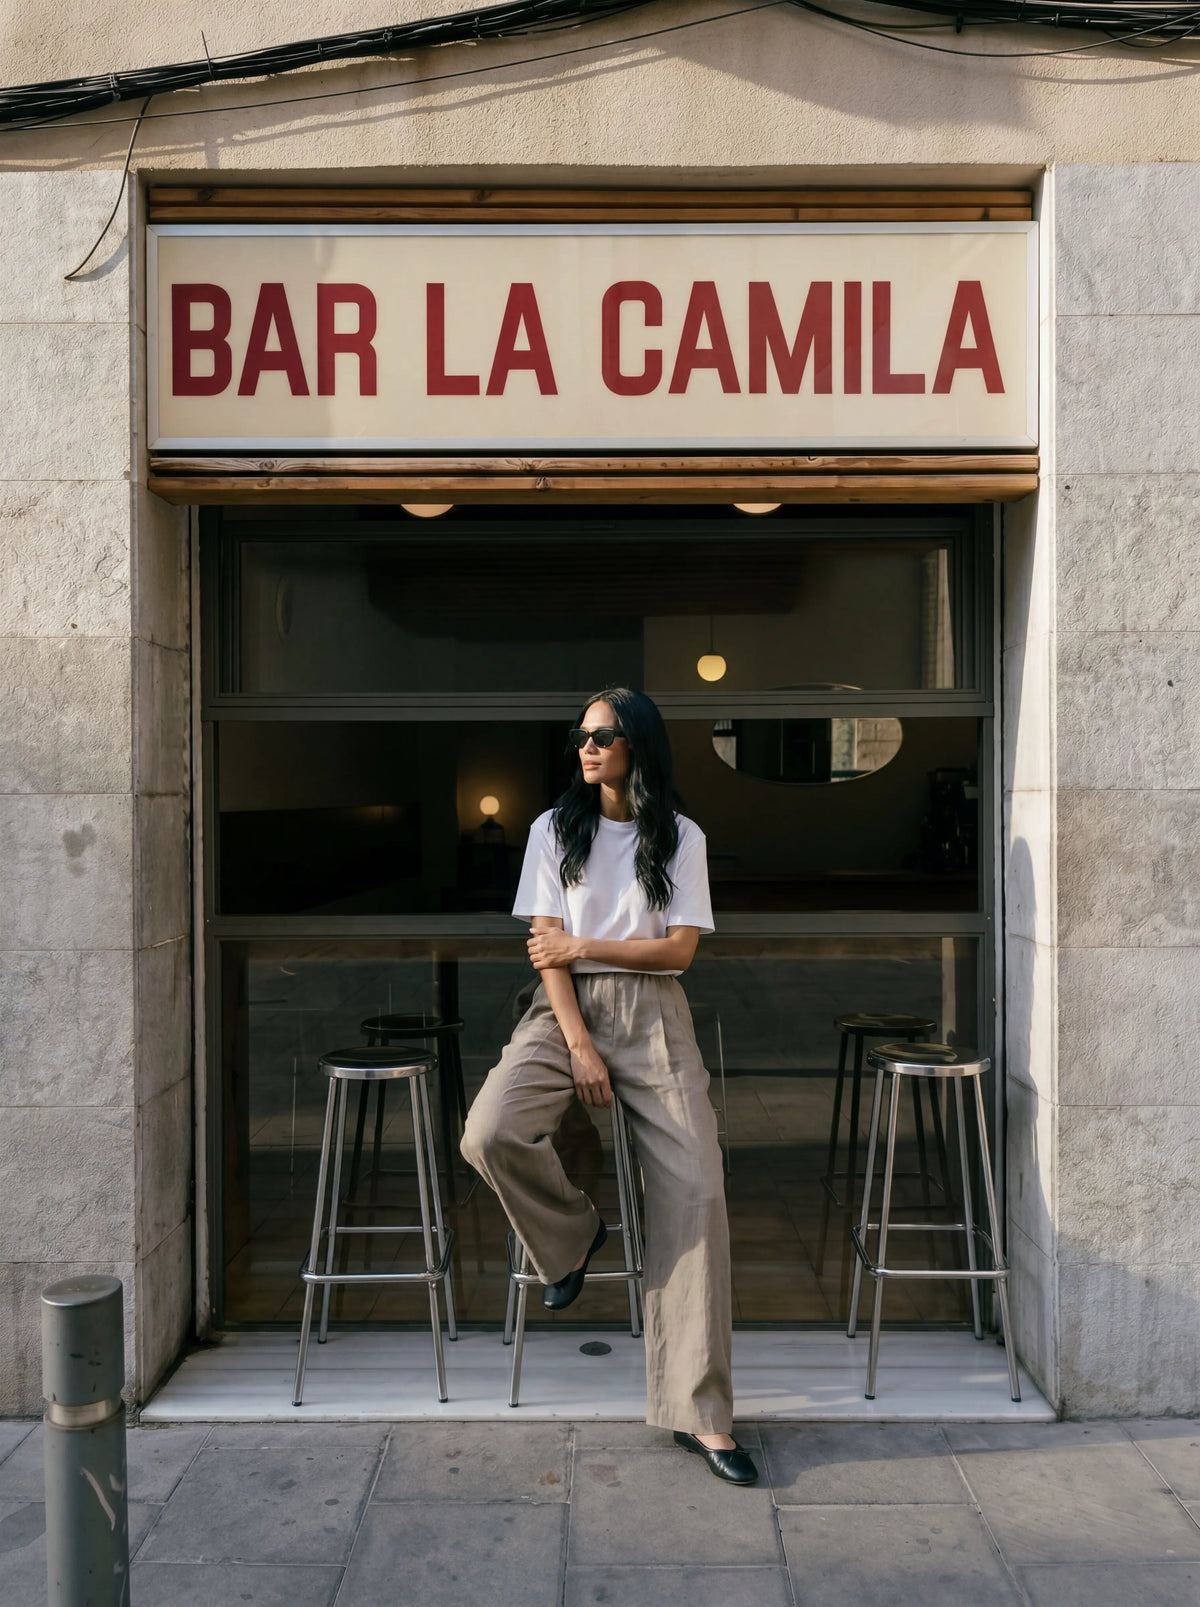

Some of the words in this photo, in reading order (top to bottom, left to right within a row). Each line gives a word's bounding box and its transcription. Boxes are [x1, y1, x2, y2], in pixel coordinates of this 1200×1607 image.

[172, 283, 378, 397] BAR
[426, 282, 559, 396] LA
[601, 280, 1006, 395] CAMILA
